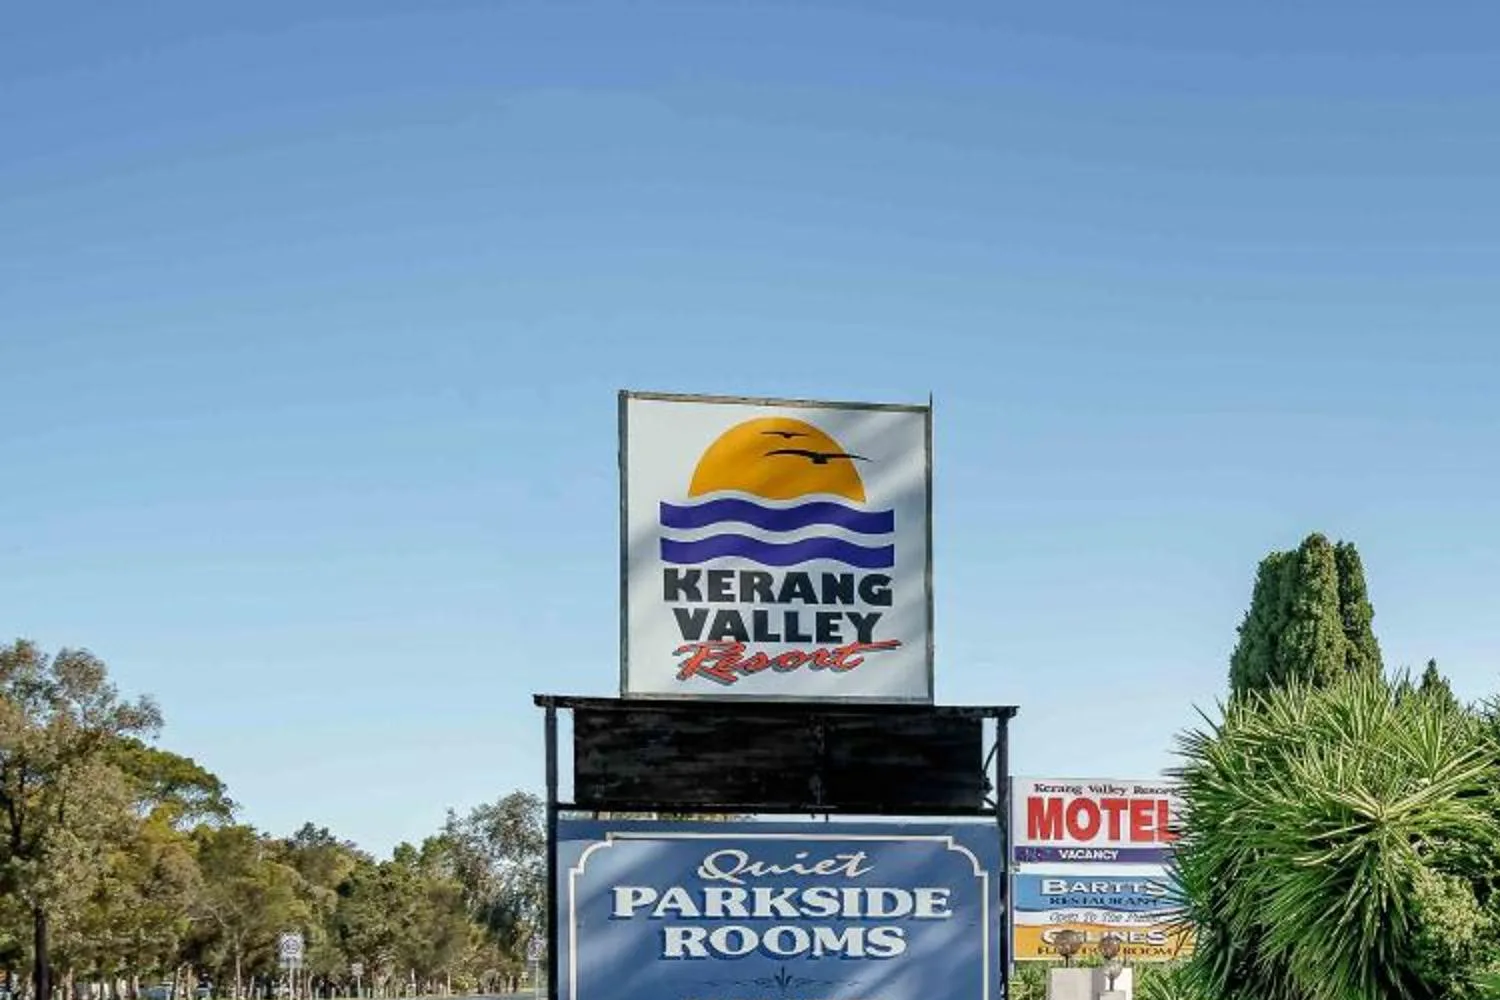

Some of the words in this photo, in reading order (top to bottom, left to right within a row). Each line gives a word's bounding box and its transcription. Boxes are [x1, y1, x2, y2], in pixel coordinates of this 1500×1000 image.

[663, 568, 893, 606] KERANG
[672, 608, 882, 644] VALLEY
[673, 640, 902, 685] Resort
[1034, 784, 1082, 796] Kerang
[1089, 784, 1127, 796] Valley
[1027, 797, 1182, 842] MOTEL
[698, 849, 875, 884] Quiet
[1058, 850, 1119, 860] VACANCY
[611, 887, 953, 919] PARKSIDE
[664, 925, 906, 958] ROOMS
